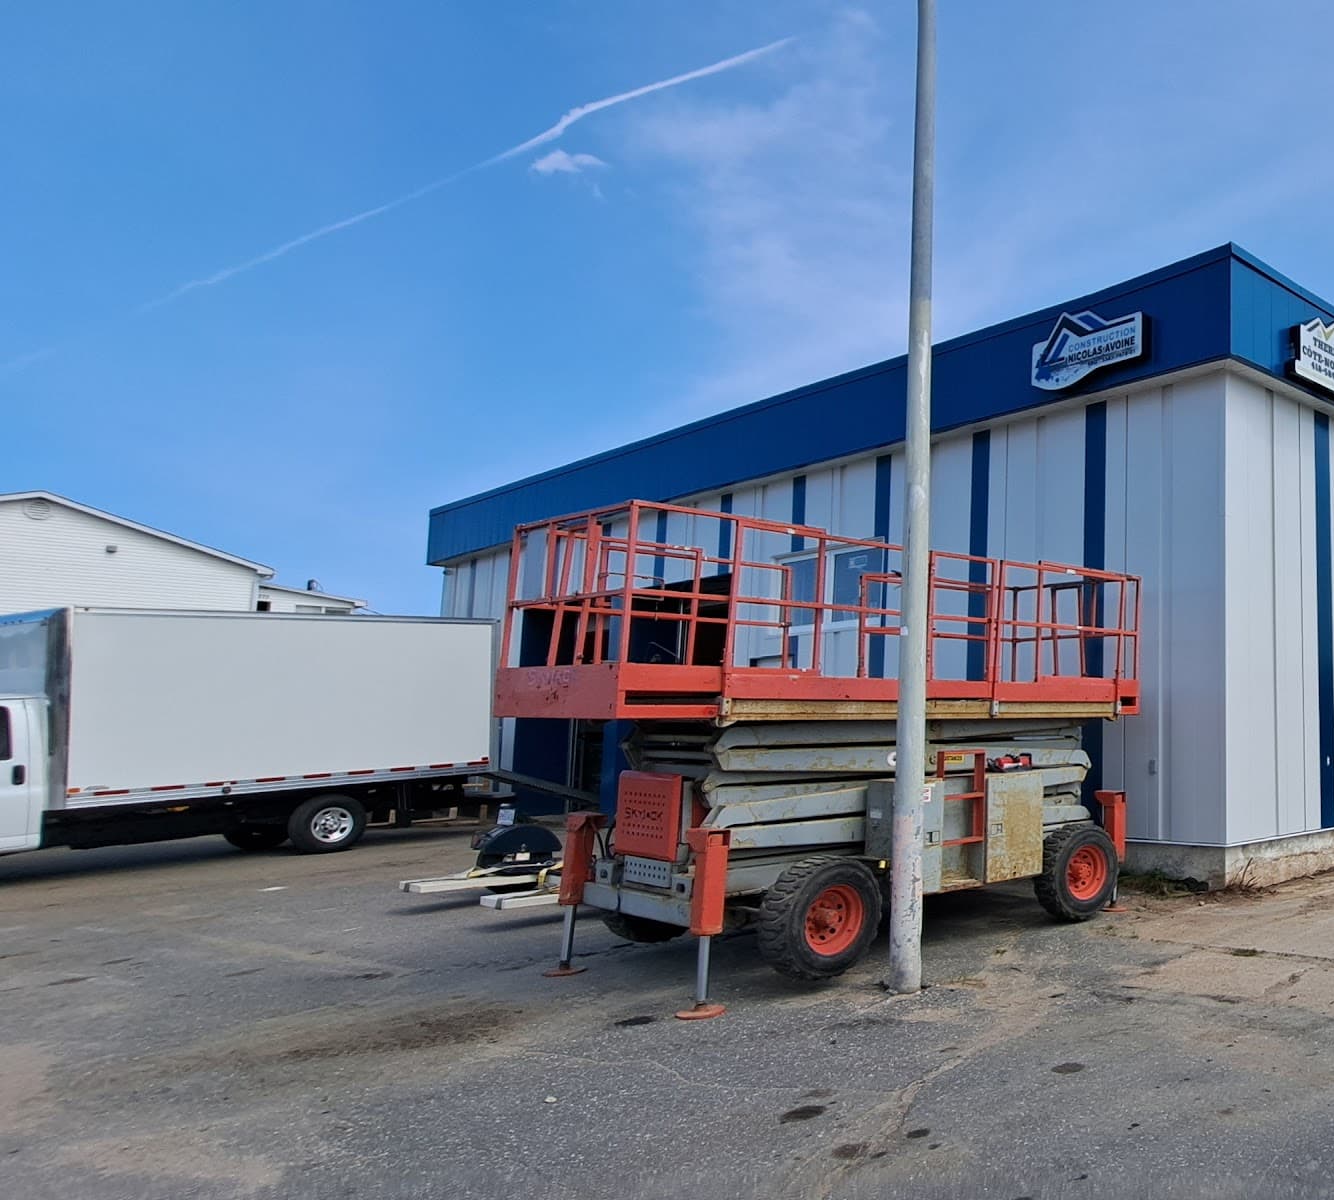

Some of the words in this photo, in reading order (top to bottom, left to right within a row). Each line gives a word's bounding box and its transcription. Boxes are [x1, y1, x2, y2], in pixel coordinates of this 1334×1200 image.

[1067, 345, 1103, 363] NICOLAS
[1105, 335, 1136, 352] AVOINE
[1068, 325, 1136, 353] CONSTRUCTION
